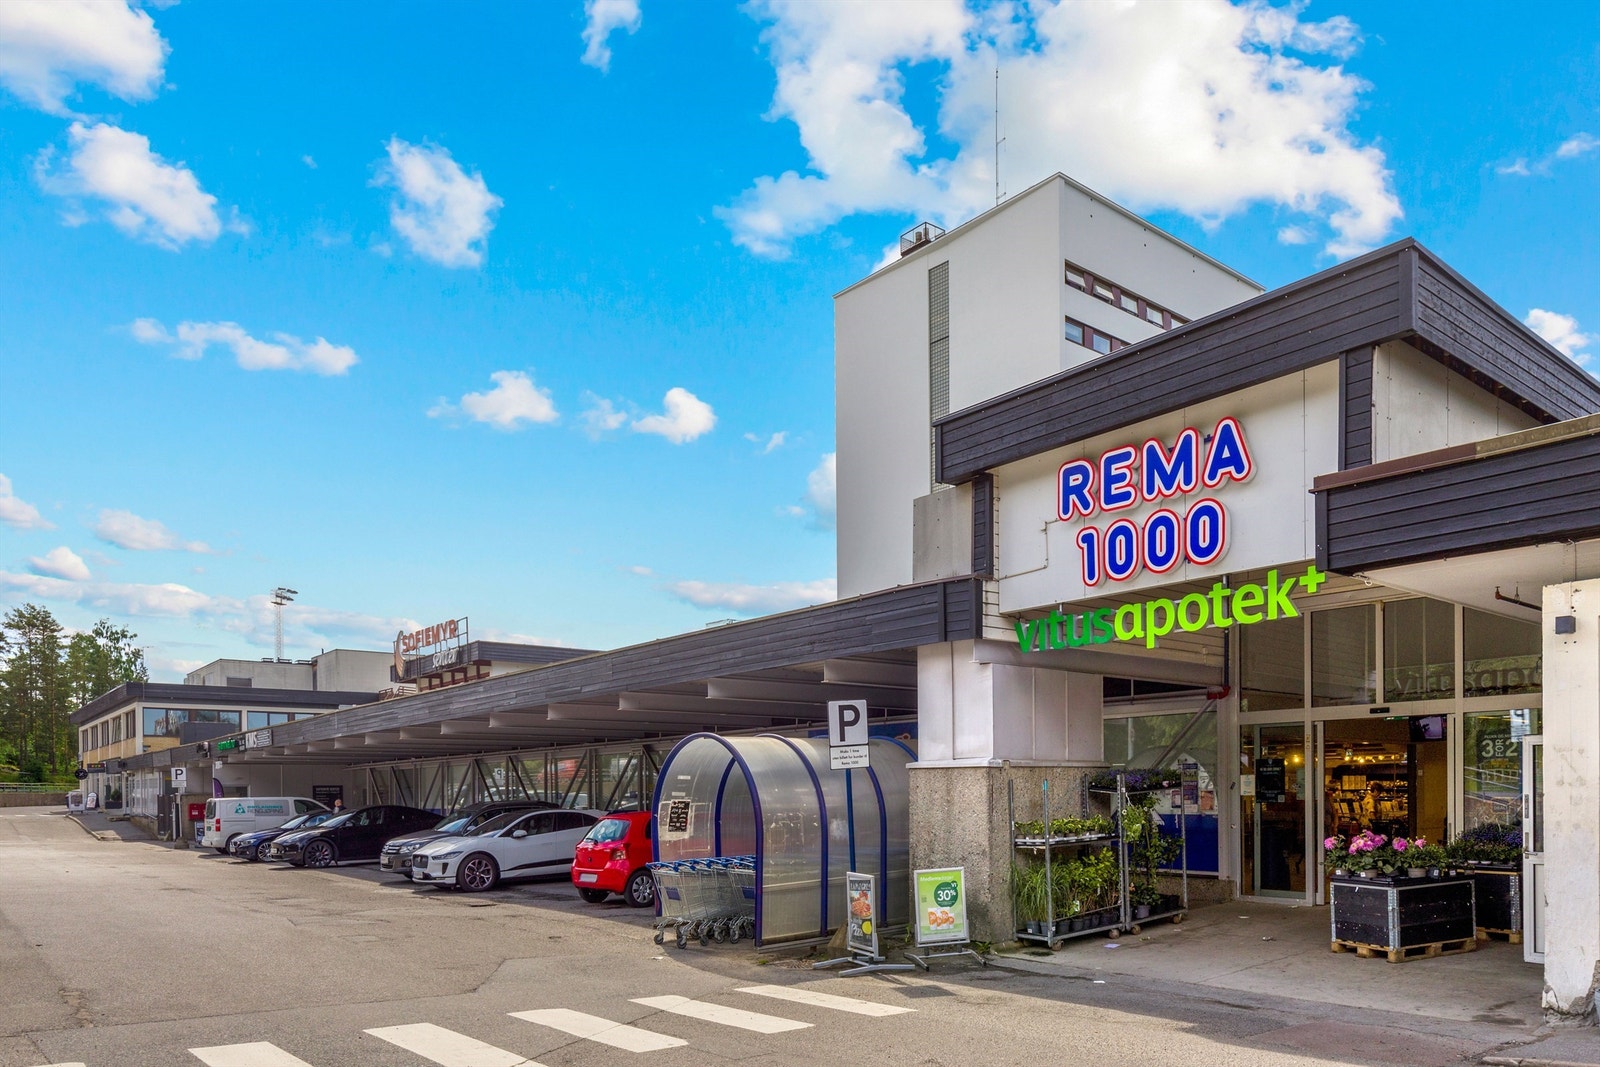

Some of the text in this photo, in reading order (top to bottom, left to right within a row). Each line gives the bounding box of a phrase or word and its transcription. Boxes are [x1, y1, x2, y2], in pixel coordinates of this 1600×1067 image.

[1057, 416, 1253, 522] REMA
[1076, 497, 1230, 588] 1000
[402, 619, 457, 653] SOFIEMYR
[432, 647, 460, 668] senter
[838, 704, 861, 742] P
[1481, 739, 1518, 757] 3 FOR 2
[175, 769, 183, 779] P
[937, 889, 956, 901] 30%
